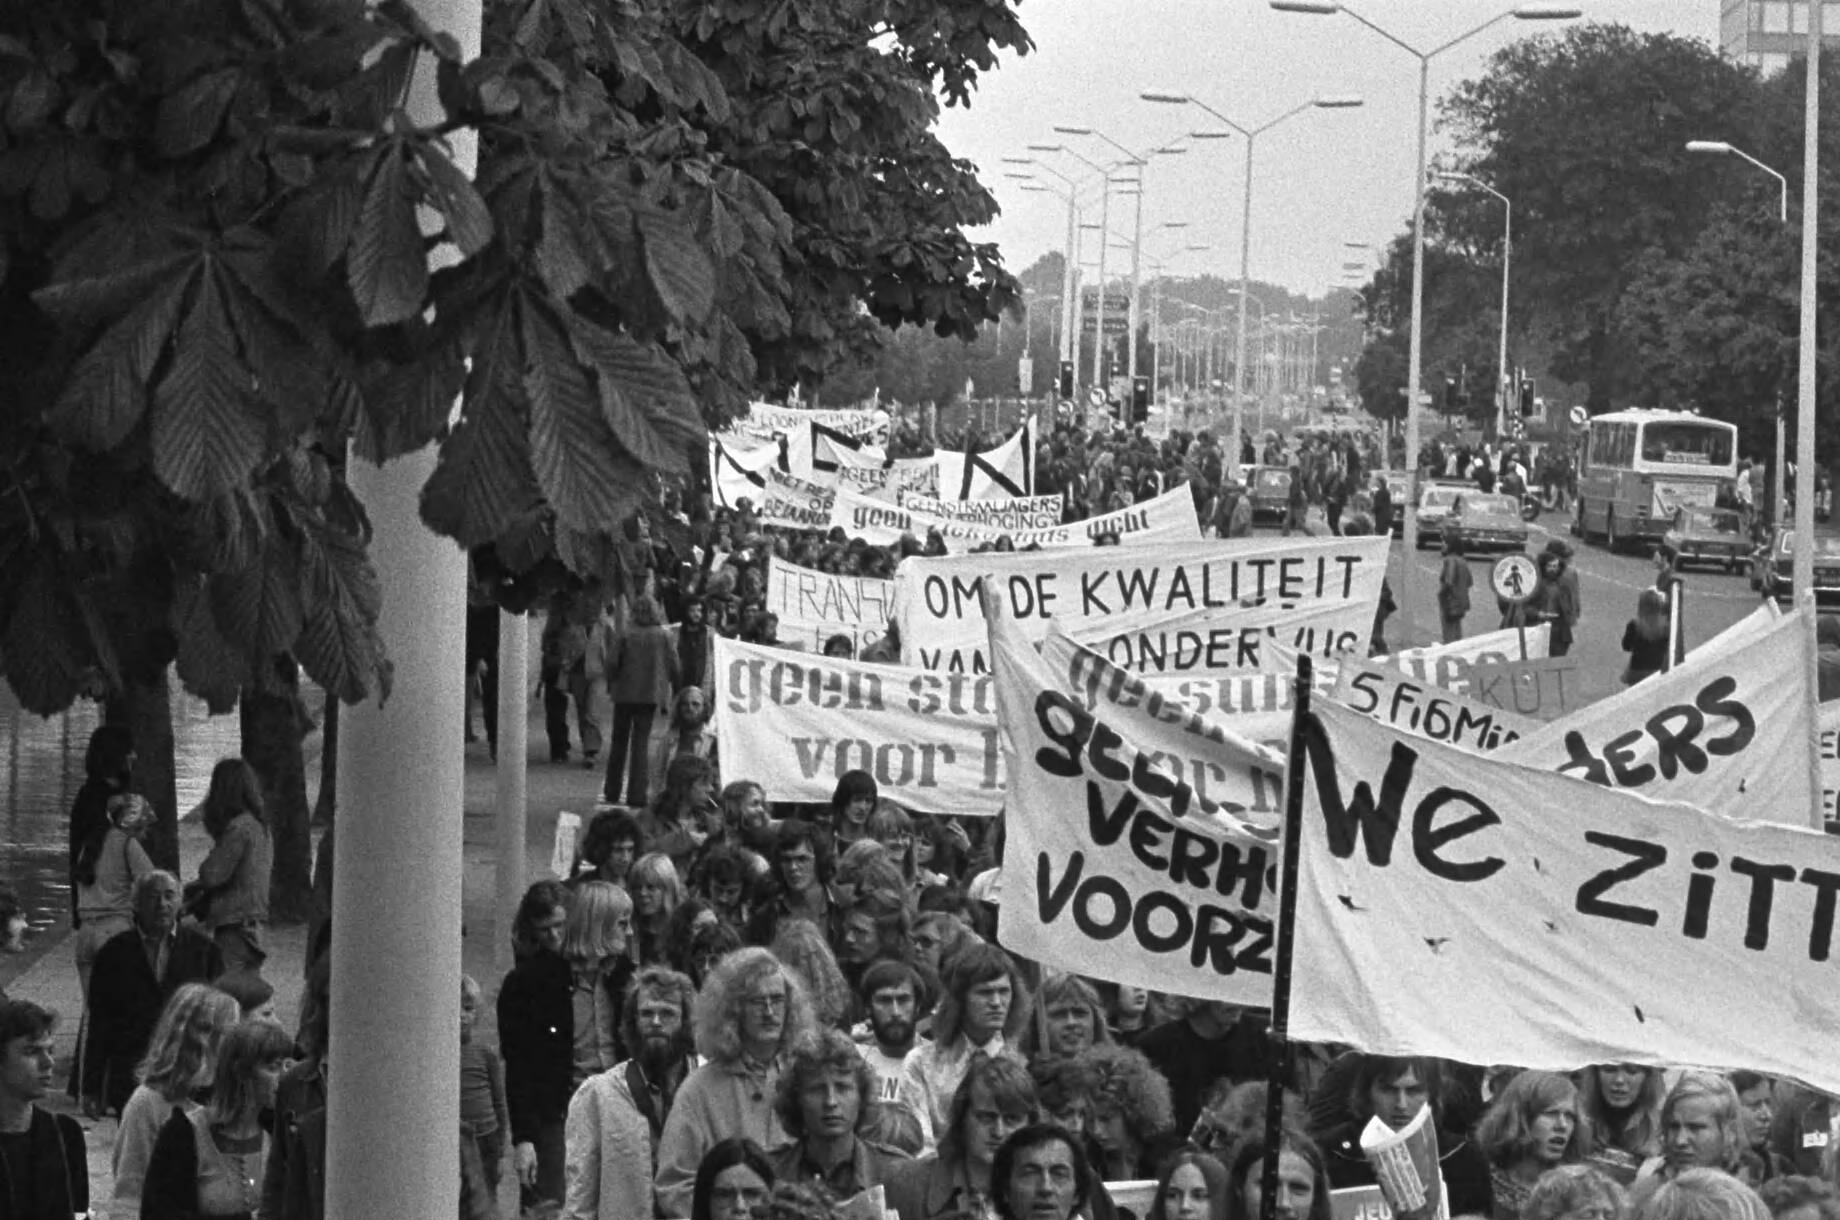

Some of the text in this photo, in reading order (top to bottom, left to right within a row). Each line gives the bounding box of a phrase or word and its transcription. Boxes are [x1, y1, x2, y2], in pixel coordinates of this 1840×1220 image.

[924, 556, 1362, 619] OM DE KWALITEIT
[728, 659, 885, 714] geen
[791, 737, 956, 788] voor
[1305, 709, 1508, 883] We
[1086, 780, 1277, 910] VERH
[1036, 850, 1274, 975] VOORZ
